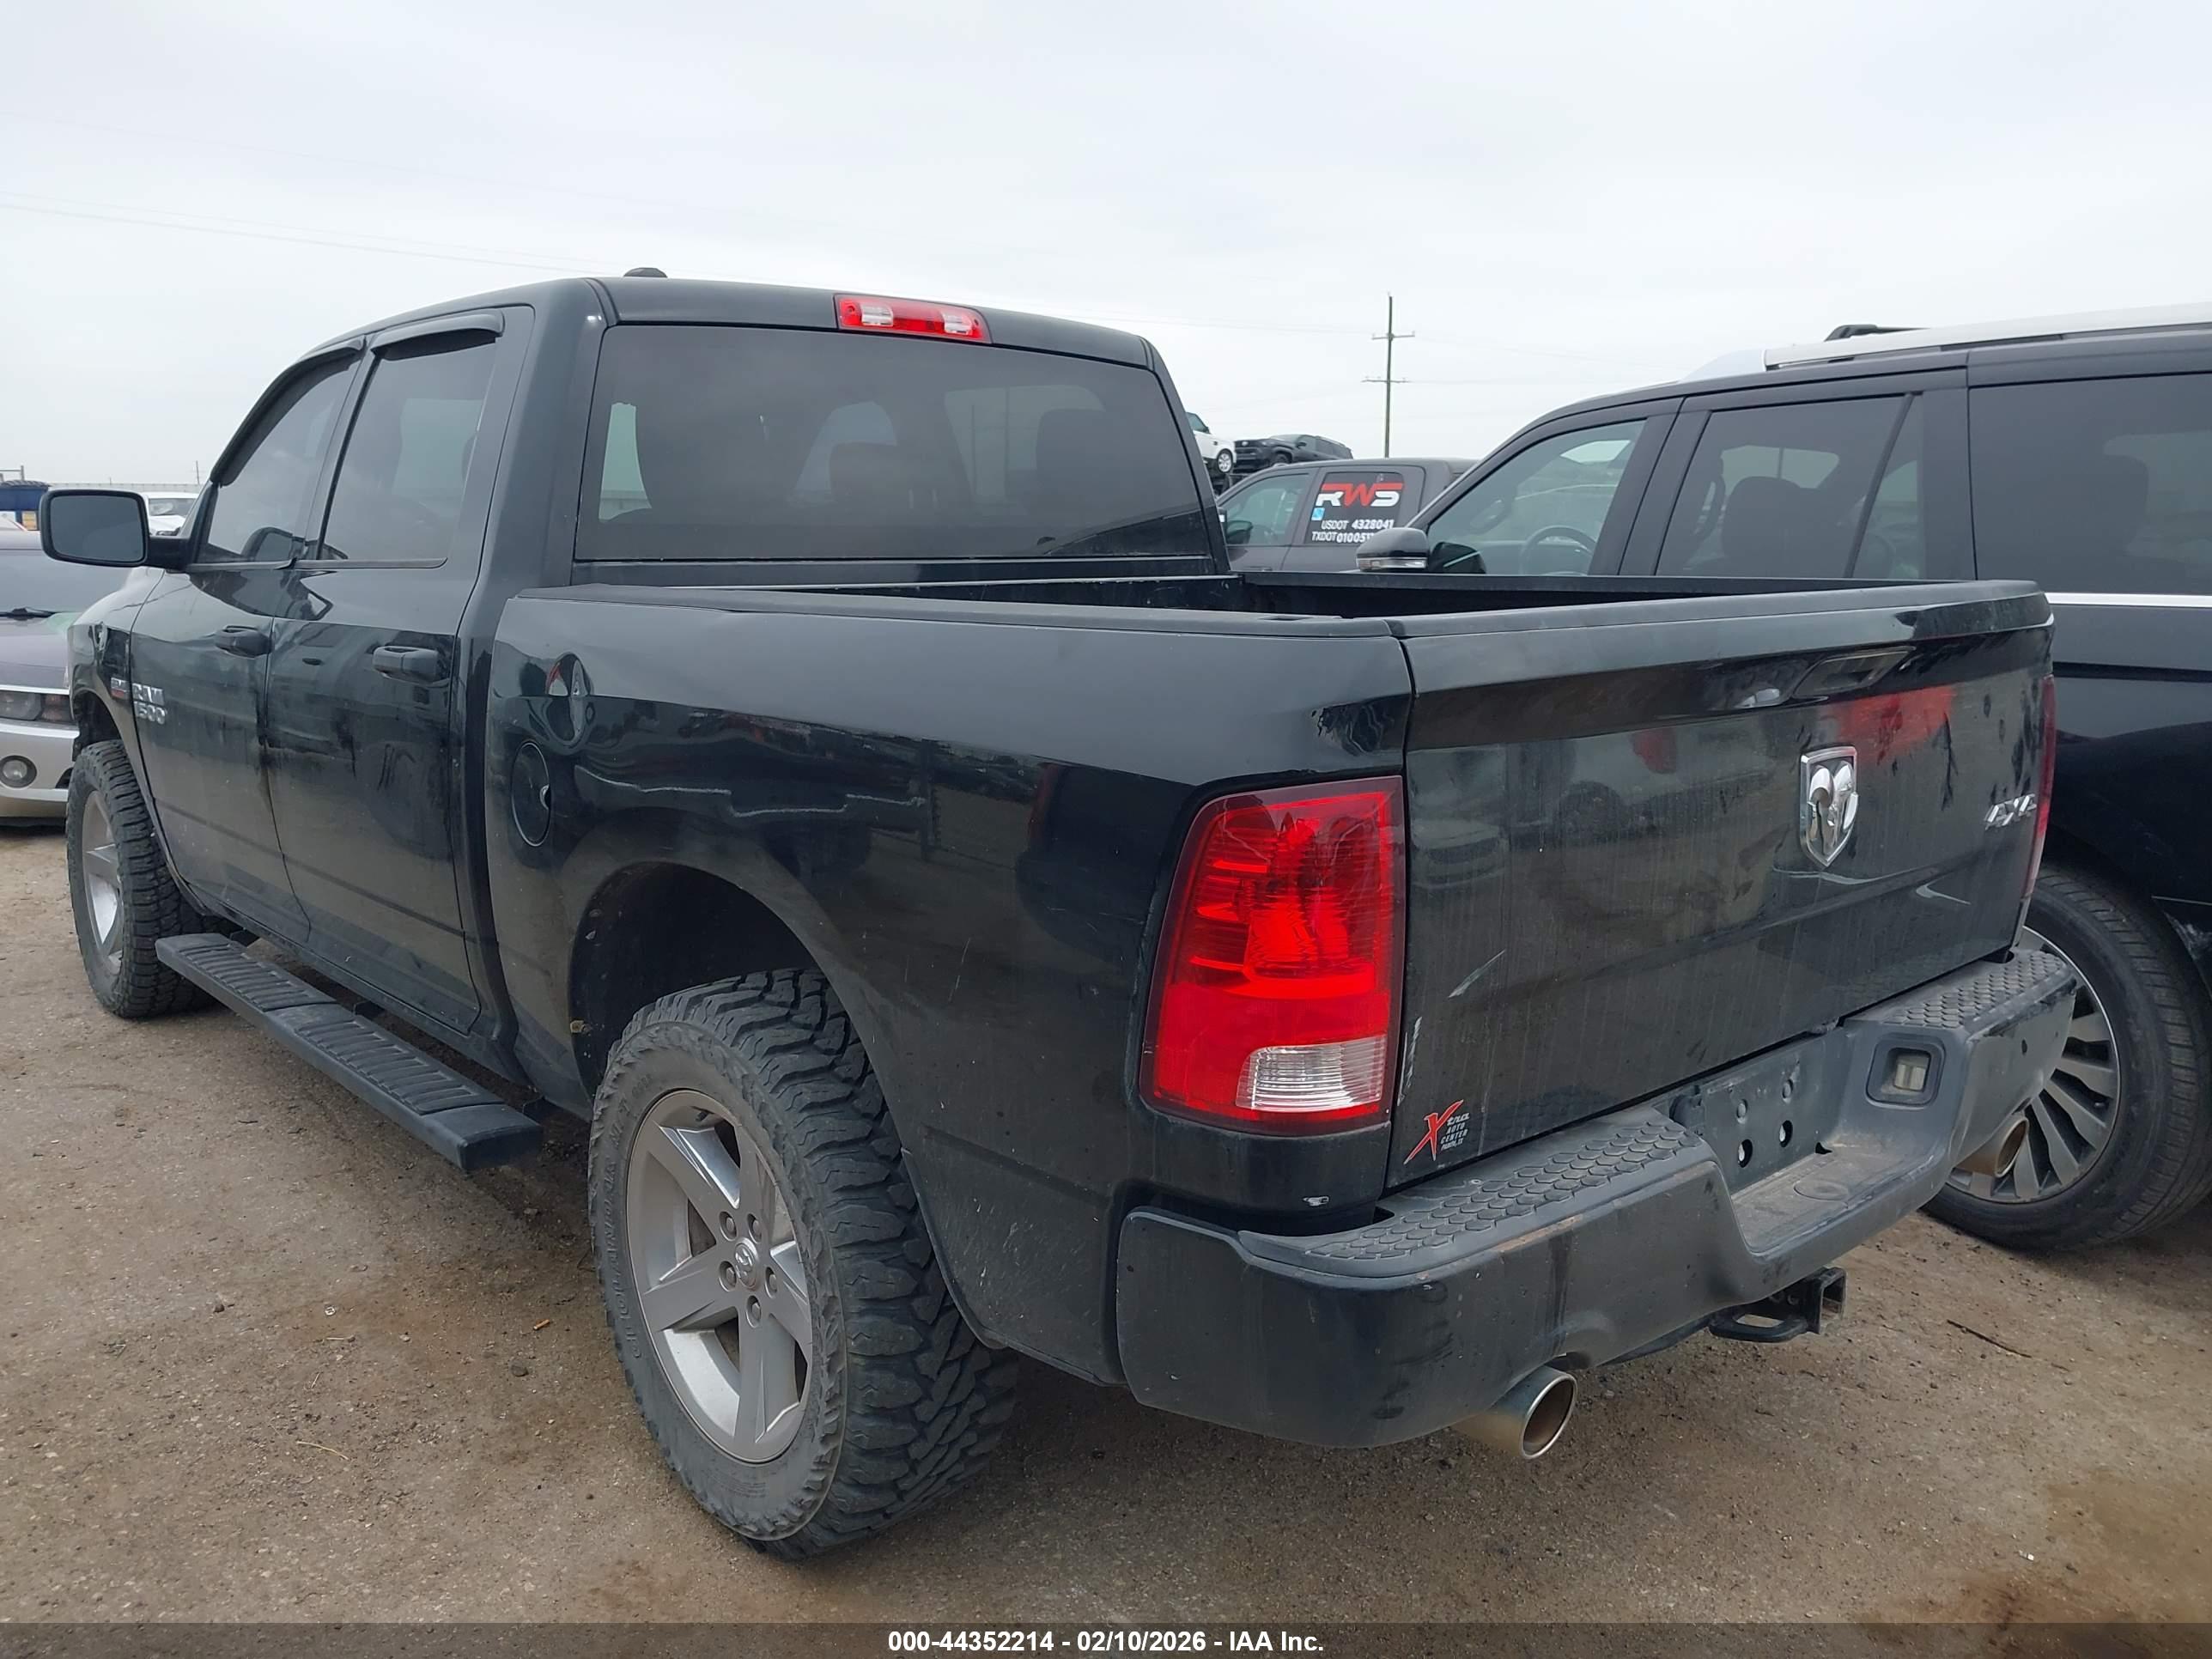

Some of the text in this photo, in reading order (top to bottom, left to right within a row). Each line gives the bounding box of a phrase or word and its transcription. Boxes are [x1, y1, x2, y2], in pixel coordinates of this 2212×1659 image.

[1316, 482, 1403, 507] RWS
[1321, 520, 1350, 530] USDOT
[1311, 531, 1337, 542] TXDOT
[132, 683, 165, 707] RAM
[1440, 1129, 1468, 1145] CENTER
